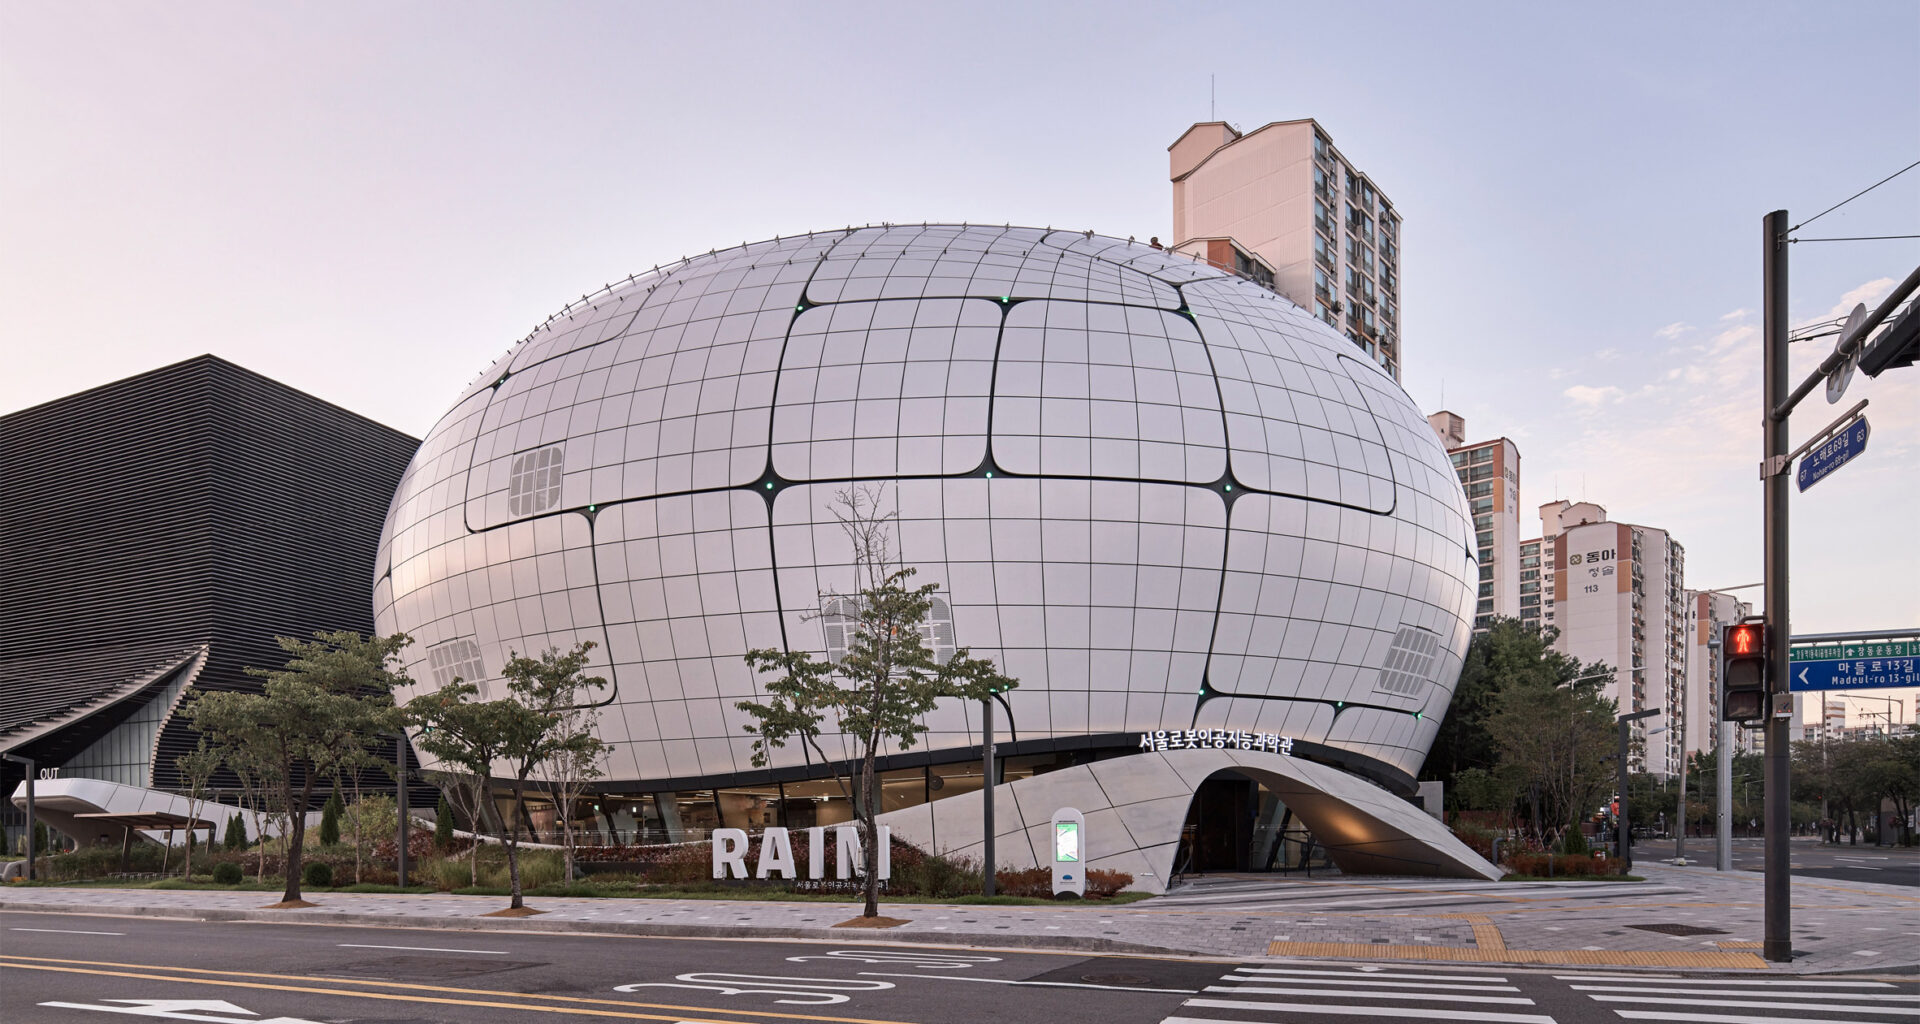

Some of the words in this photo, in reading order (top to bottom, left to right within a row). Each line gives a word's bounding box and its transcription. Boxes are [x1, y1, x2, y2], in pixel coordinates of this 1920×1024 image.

[1586, 548, 1616, 563] 동아
[1584, 584, 1599, 593] 113
[1858, 645, 1902, 657] 창동운동장
[1832, 674, 1885, 685] Madeul-ro
[1889, 672, 1920, 684] 13-gil
[1139, 728, 1294, 755] 서울로봇인공지능과학관
[40, 767, 59, 780] OUT
[712, 826, 891, 880] RAIM
